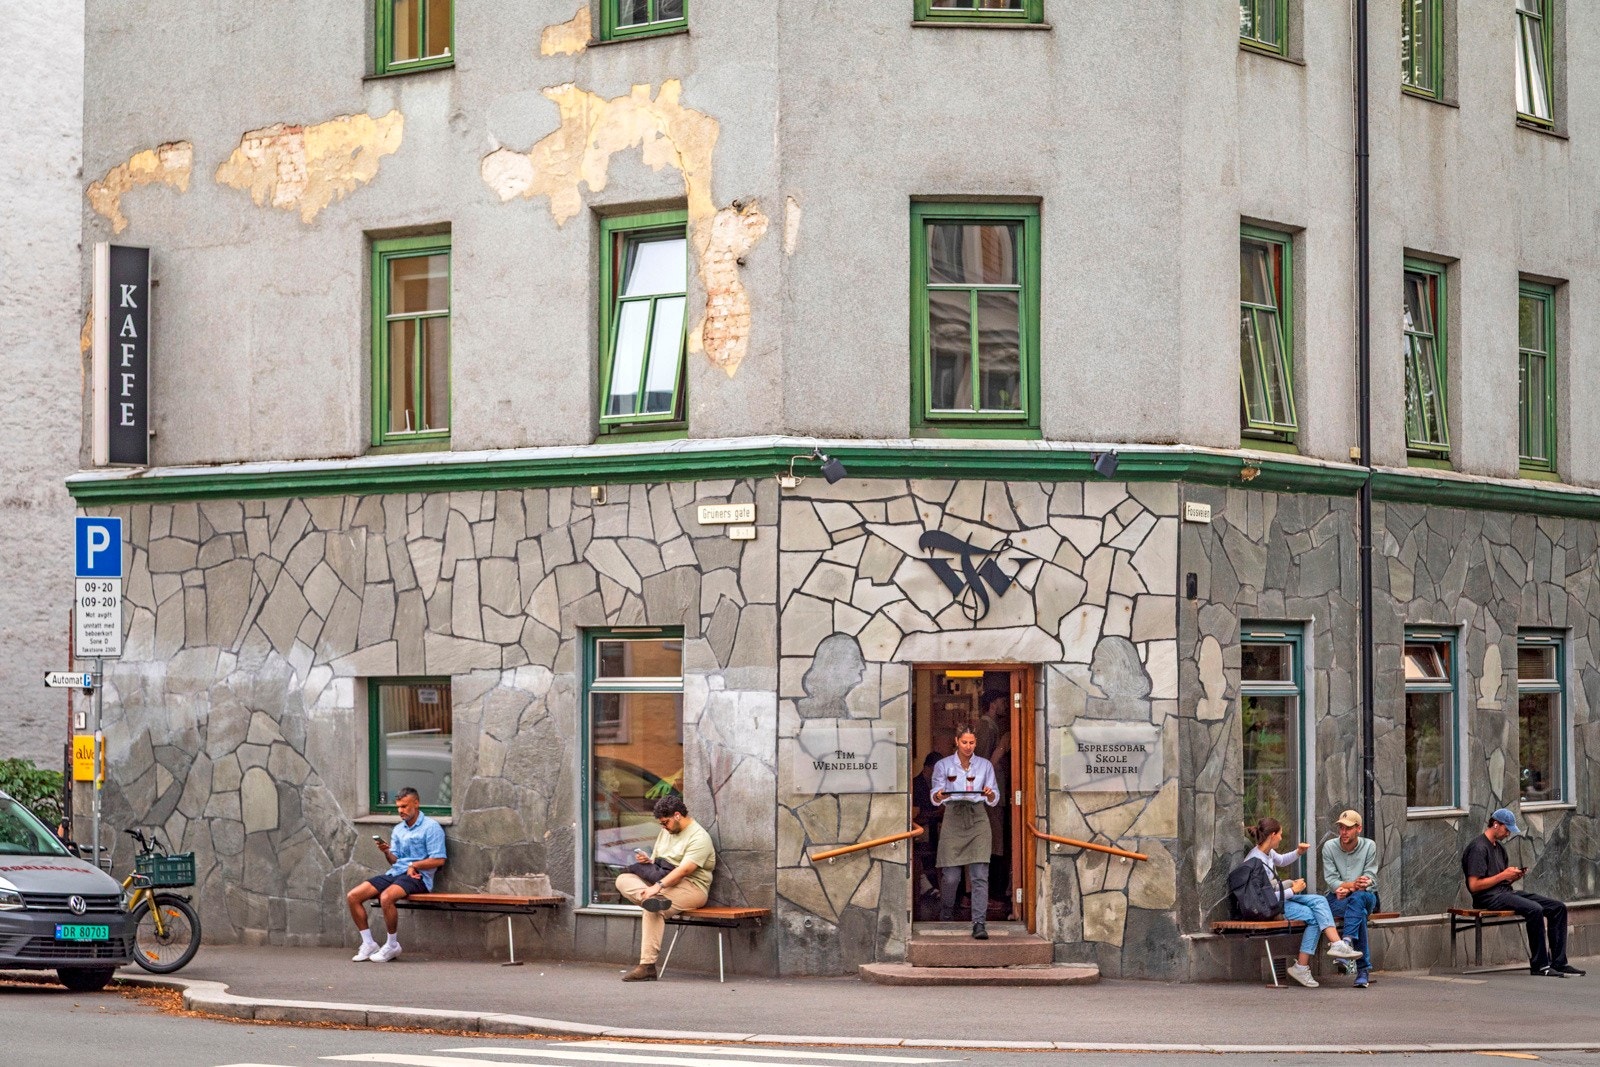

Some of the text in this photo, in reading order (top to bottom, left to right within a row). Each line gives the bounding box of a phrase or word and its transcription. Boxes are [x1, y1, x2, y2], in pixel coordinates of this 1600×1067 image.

[119, 283, 138, 426] KAFFE
[735, 508, 750, 520] gate
[87, 525, 111, 569] P
[52, 675, 83, 685] Automat
[1078, 743, 1146, 753] ESPRESSOBAR
[1096, 754, 1128, 763] SKOLE
[813, 762, 878, 770] WENDELBOE
[1085, 765, 1138, 774] BRENNERI
[63, 927, 76, 937] DR
[79, 927, 107, 937] 80703
